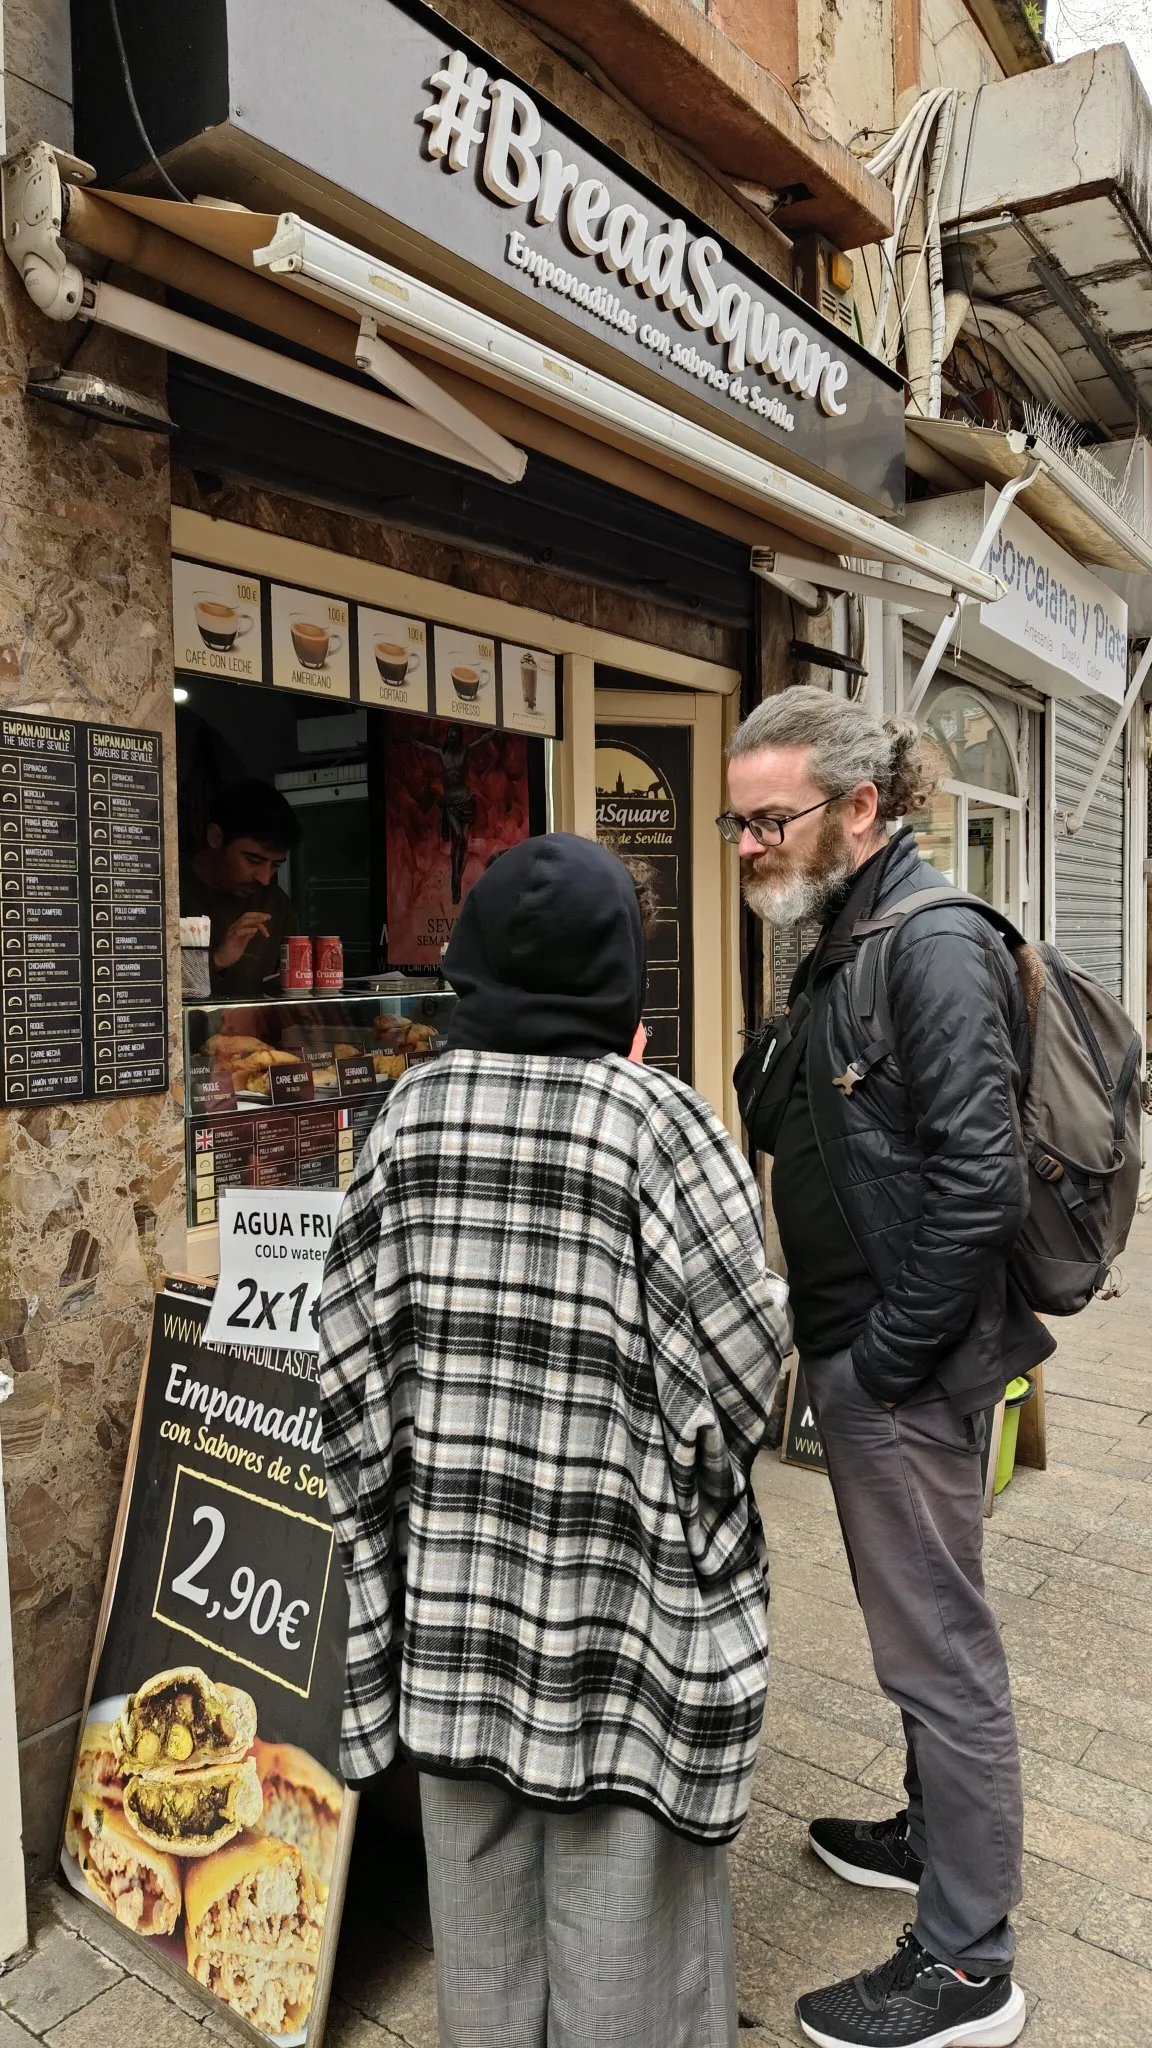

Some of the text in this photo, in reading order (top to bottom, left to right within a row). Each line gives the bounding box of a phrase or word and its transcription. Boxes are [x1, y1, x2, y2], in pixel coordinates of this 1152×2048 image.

[423, 50, 848, 416] #BreadSquare
[508, 231, 795, 431] Empanadillas con sabores de Sevilla
[185, 648, 253, 674] CAFÉ CON LECHE
[291, 670, 332, 689] AMERICANO
[380, 686, 408, 703] CORTADO
[451, 701, 480, 717] EXPRESSO
[3, 721, 70, 741] EMPANADILLAS
[4, 735, 69, 752] THE TASTE OF SEVILLE
[93, 734, 153, 752] EMPANADILLAS
[94, 747, 152, 763] SAVEURS DE SEVILLE
[634, 832, 673, 844] Sevilla
[427, 918, 458, 933] SEV
[276, 1074, 292, 1084] CARNE
[345, 1067, 368, 1076] SERRANITO
[202, 1082, 220, 1092] ROQUE
[232, 1211, 333, 1238] AGUA FRI
[255, 1244, 327, 1261] COLD water
[159, 1420, 328, 1499] con Sabores de Sev
[171, 1504, 311, 1651] 2,90€
